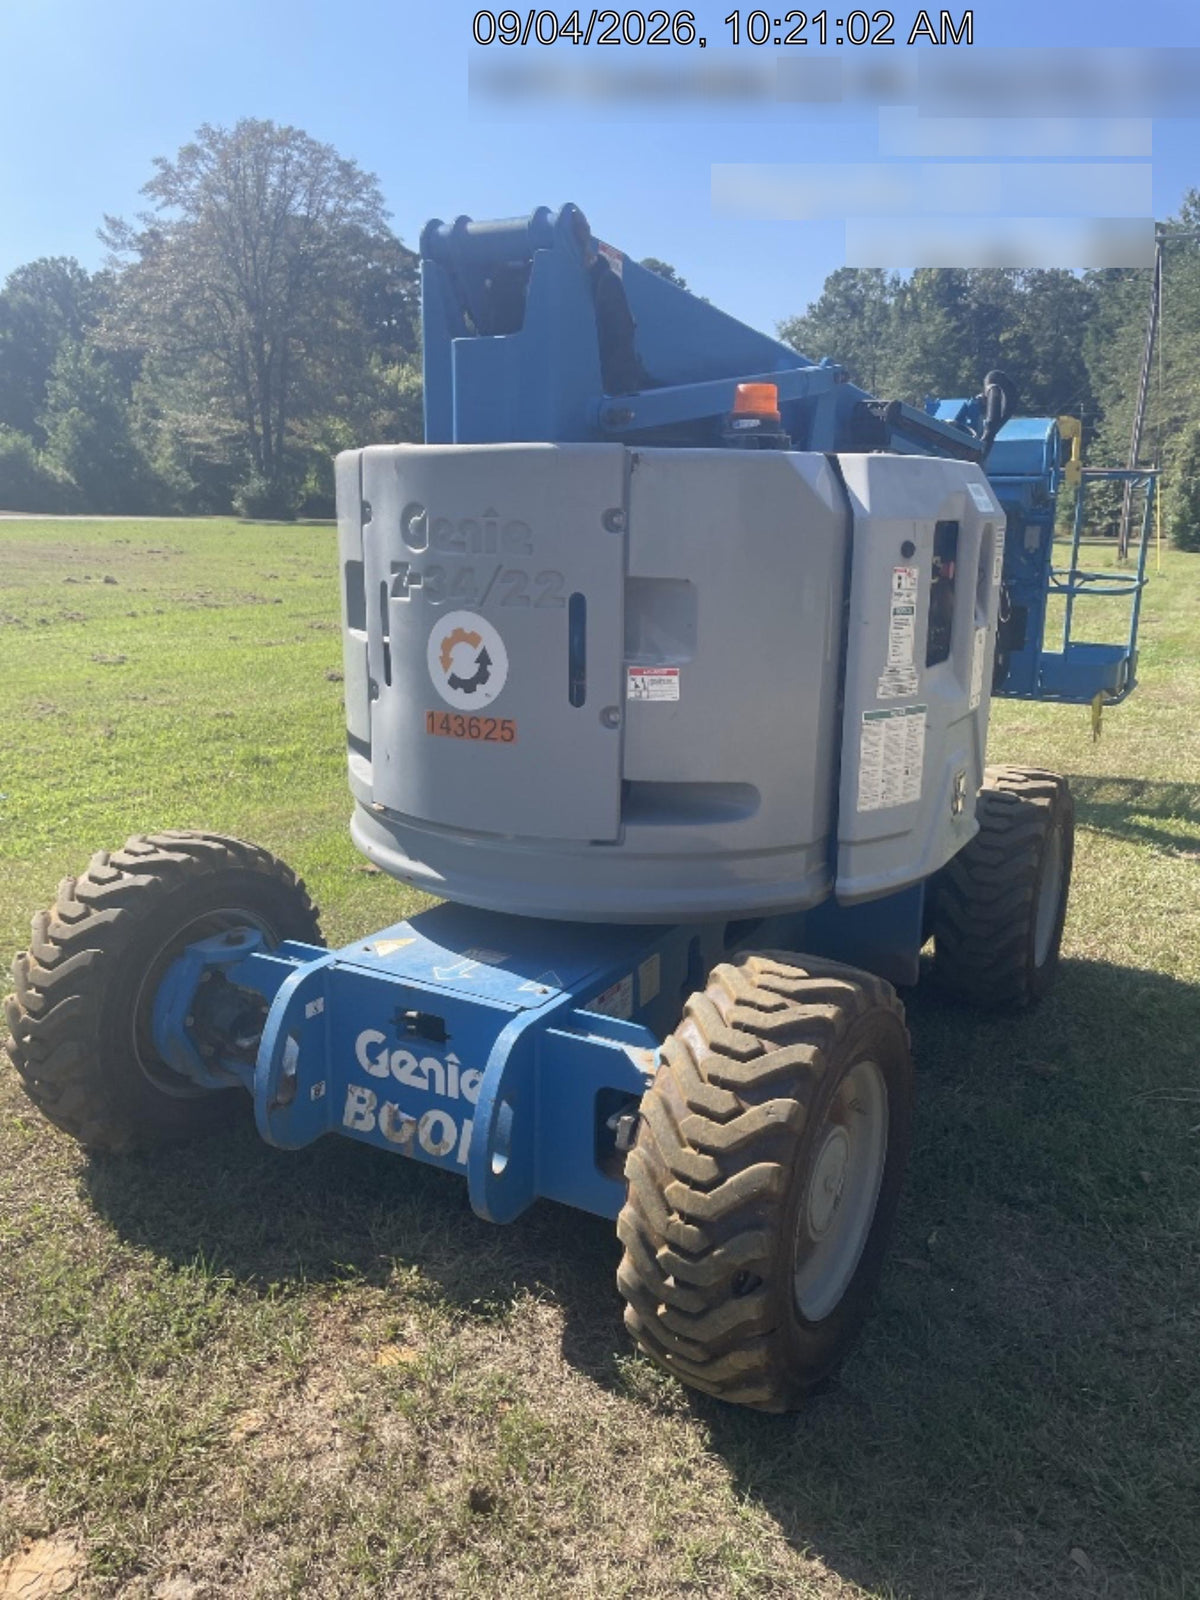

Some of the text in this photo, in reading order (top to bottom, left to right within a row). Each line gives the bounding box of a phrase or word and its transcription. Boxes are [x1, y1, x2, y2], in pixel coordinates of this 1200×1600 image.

[401, 501, 533, 556] Genie
[390, 560, 567, 608] Z-34/22
[428, 710, 515, 742] 143625
[343, 1083, 474, 1165] BOO
